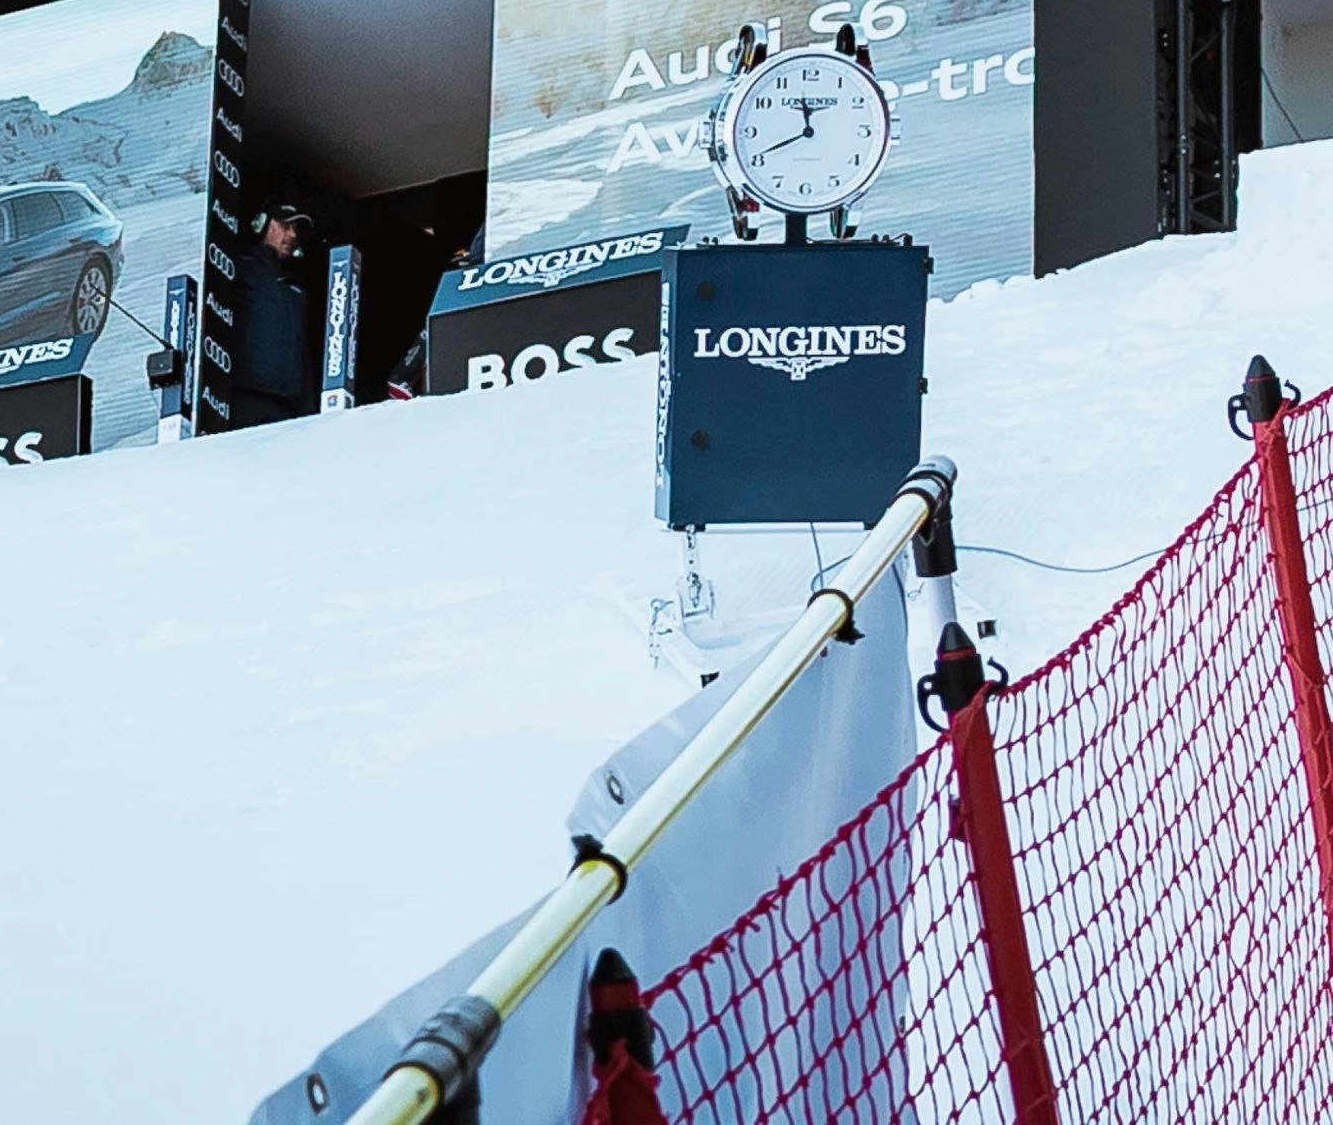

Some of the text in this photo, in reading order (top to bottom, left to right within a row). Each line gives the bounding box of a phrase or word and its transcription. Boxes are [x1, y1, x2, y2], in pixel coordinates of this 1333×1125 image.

[222, 15, 247, 52] Audi
[776, 77, 788, 89] 11
[802, 69, 820, 82] 12
[755, 97, 772, 110] 10
[216, 106, 243, 143] Audi
[212, 199, 239, 235] Audi
[457, 231, 665, 291] LONGINES
[206, 292, 233, 327] Audi
[693, 324, 907, 359] LONGINES
[468, 327, 635, 392] BOSS
[202, 386, 230, 420] Audi
